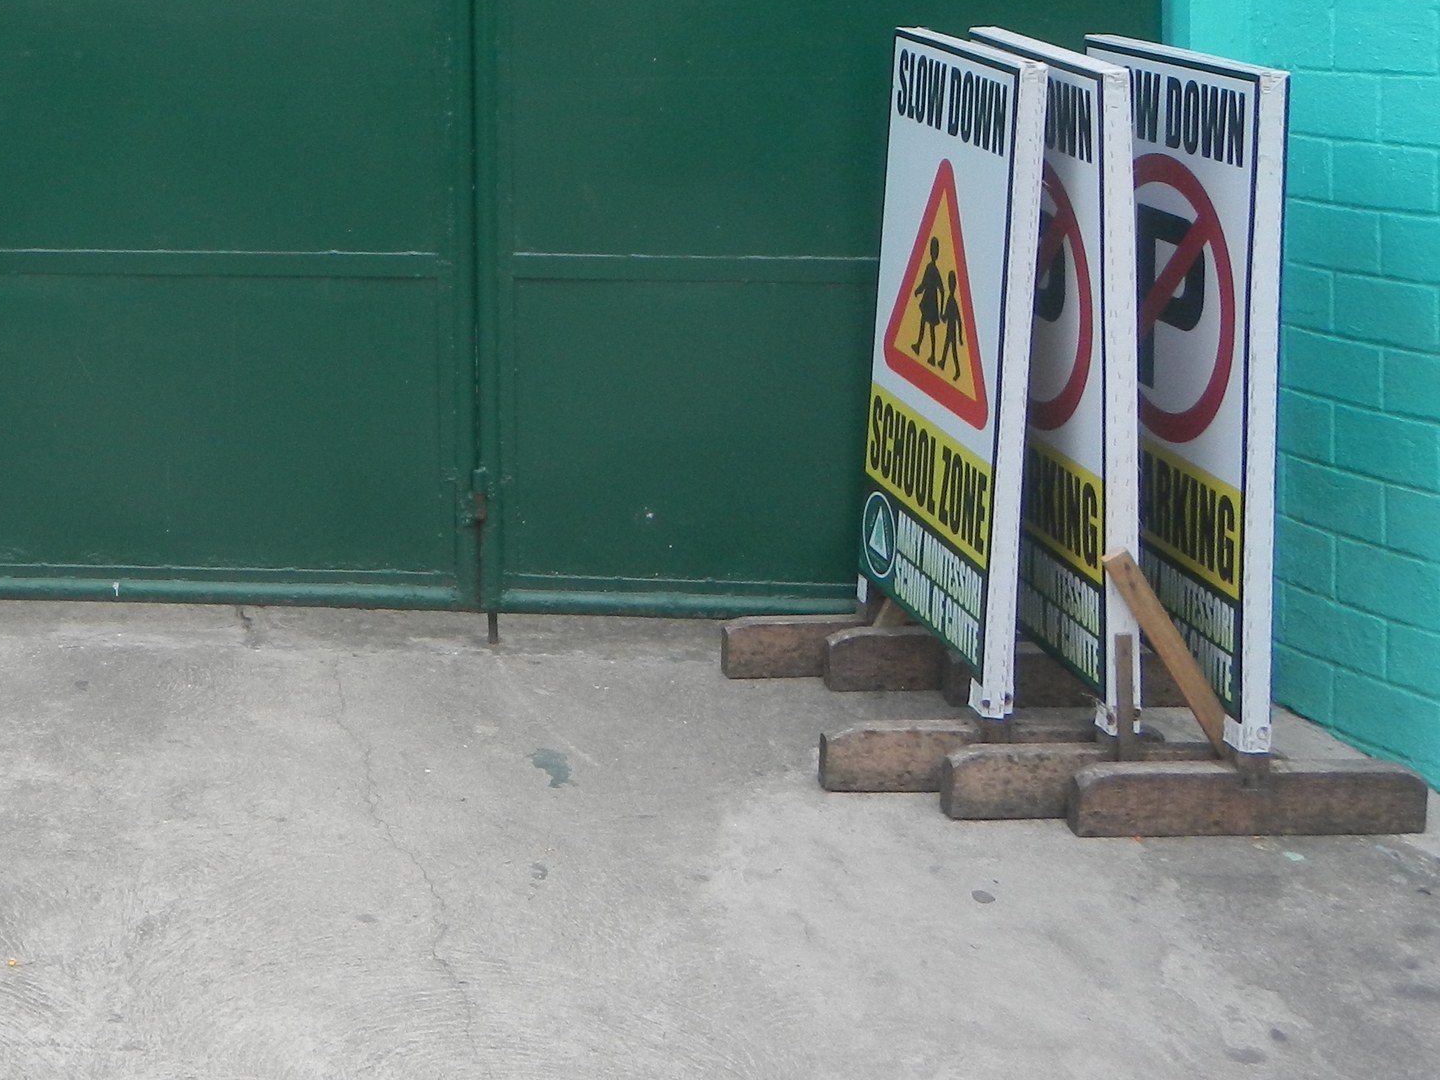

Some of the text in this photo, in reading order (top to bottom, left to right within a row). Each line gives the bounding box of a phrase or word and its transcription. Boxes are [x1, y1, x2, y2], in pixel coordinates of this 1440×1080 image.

[897, 48, 1007, 157] SLOW DOWN
[1165, 76, 1246, 168] DOWN
[869, 395, 936, 516] SCHOOL
[938, 448, 988, 556] ZONE
[894, 553, 980, 666] SCHOOL OF CAVITE
[897, 510, 923, 567] MARY
[922, 530, 983, 620] MONTESSORI
